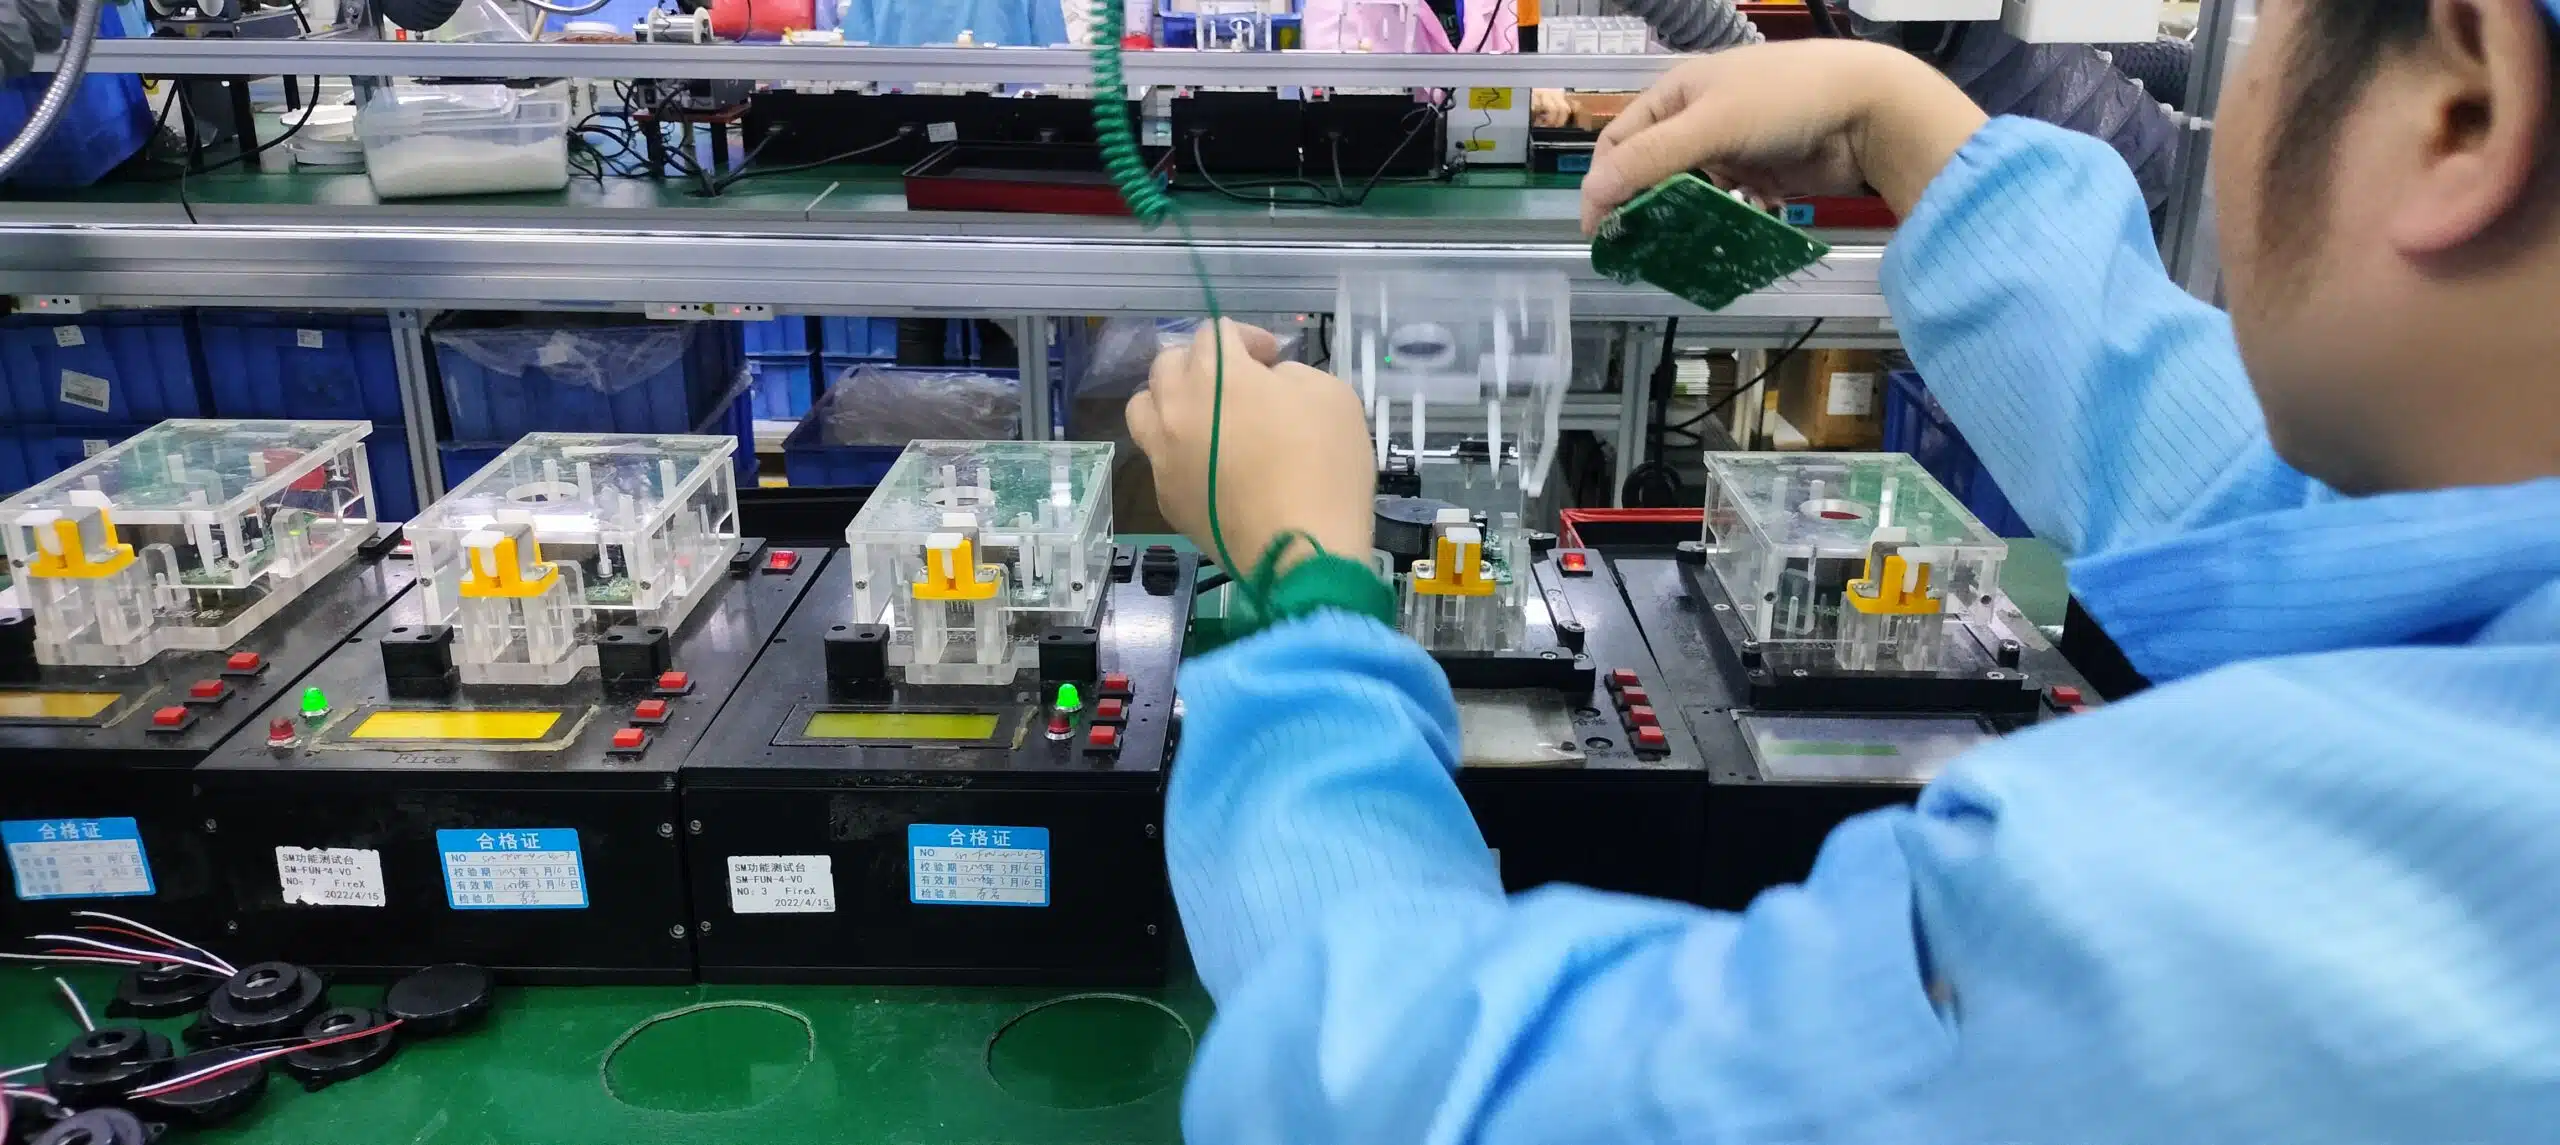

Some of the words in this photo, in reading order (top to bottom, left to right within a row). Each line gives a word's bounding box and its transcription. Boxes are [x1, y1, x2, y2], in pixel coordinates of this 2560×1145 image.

[38, 822, 103, 840] 合格证
[476, 832, 541, 850] 合格证
[948, 828, 1012, 847] 合格证
[920, 848, 935, 857] NO
[282, 853, 354, 865] SM功能测试台
[451, 853, 466, 863] NO
[454, 867, 491, 877] 校验期
[735, 863, 806, 873] SM功能测试台
[920, 862, 957, 873] 校验期
[334, 880, 365, 888] FireX
[456, 881, 493, 890] 有效期
[921, 876, 957, 886] 有效期
[324, 890, 380, 900] 2022/4/15
[761, 887, 768, 895] 3
[785, 887, 816, 895] FireX
[774, 898, 830, 907] 2022/4/15
